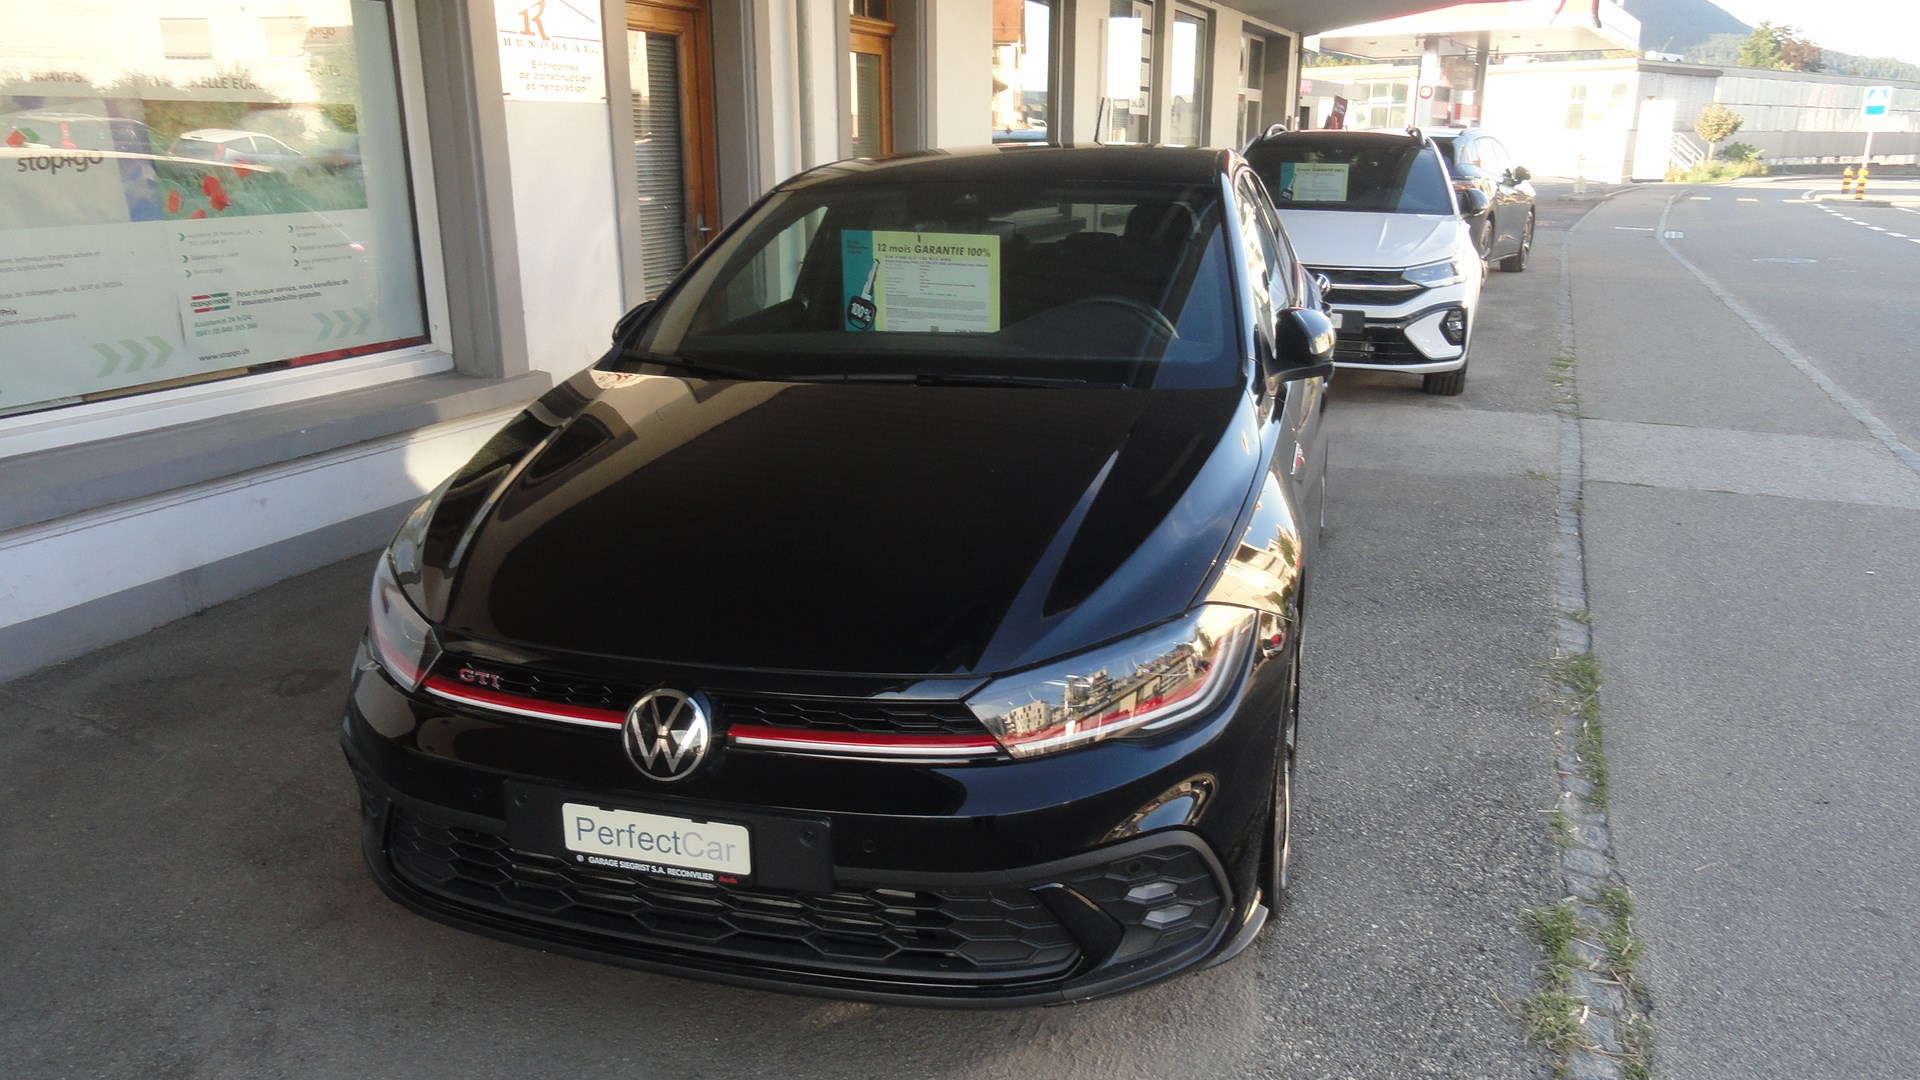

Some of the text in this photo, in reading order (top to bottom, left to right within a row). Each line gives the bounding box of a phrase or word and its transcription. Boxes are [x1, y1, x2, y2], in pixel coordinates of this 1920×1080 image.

[503, 37, 590, 54] RENORVAL
[877, 243, 887, 252] 12
[888, 244, 912, 254] mois
[914, 245, 965, 256] GARANTIE
[967, 247, 992, 257] 100%
[850, 302, 872, 322] 100%
[458, 667, 501, 690] GTI
[575, 816, 737, 863] PerfectCar
[588, 856, 619, 868] GARAGE
[619, 860, 650, 872] SIEGRIST
[651, 865, 666, 875] S.A.
[666, 867, 715, 881] RECONVILIER
